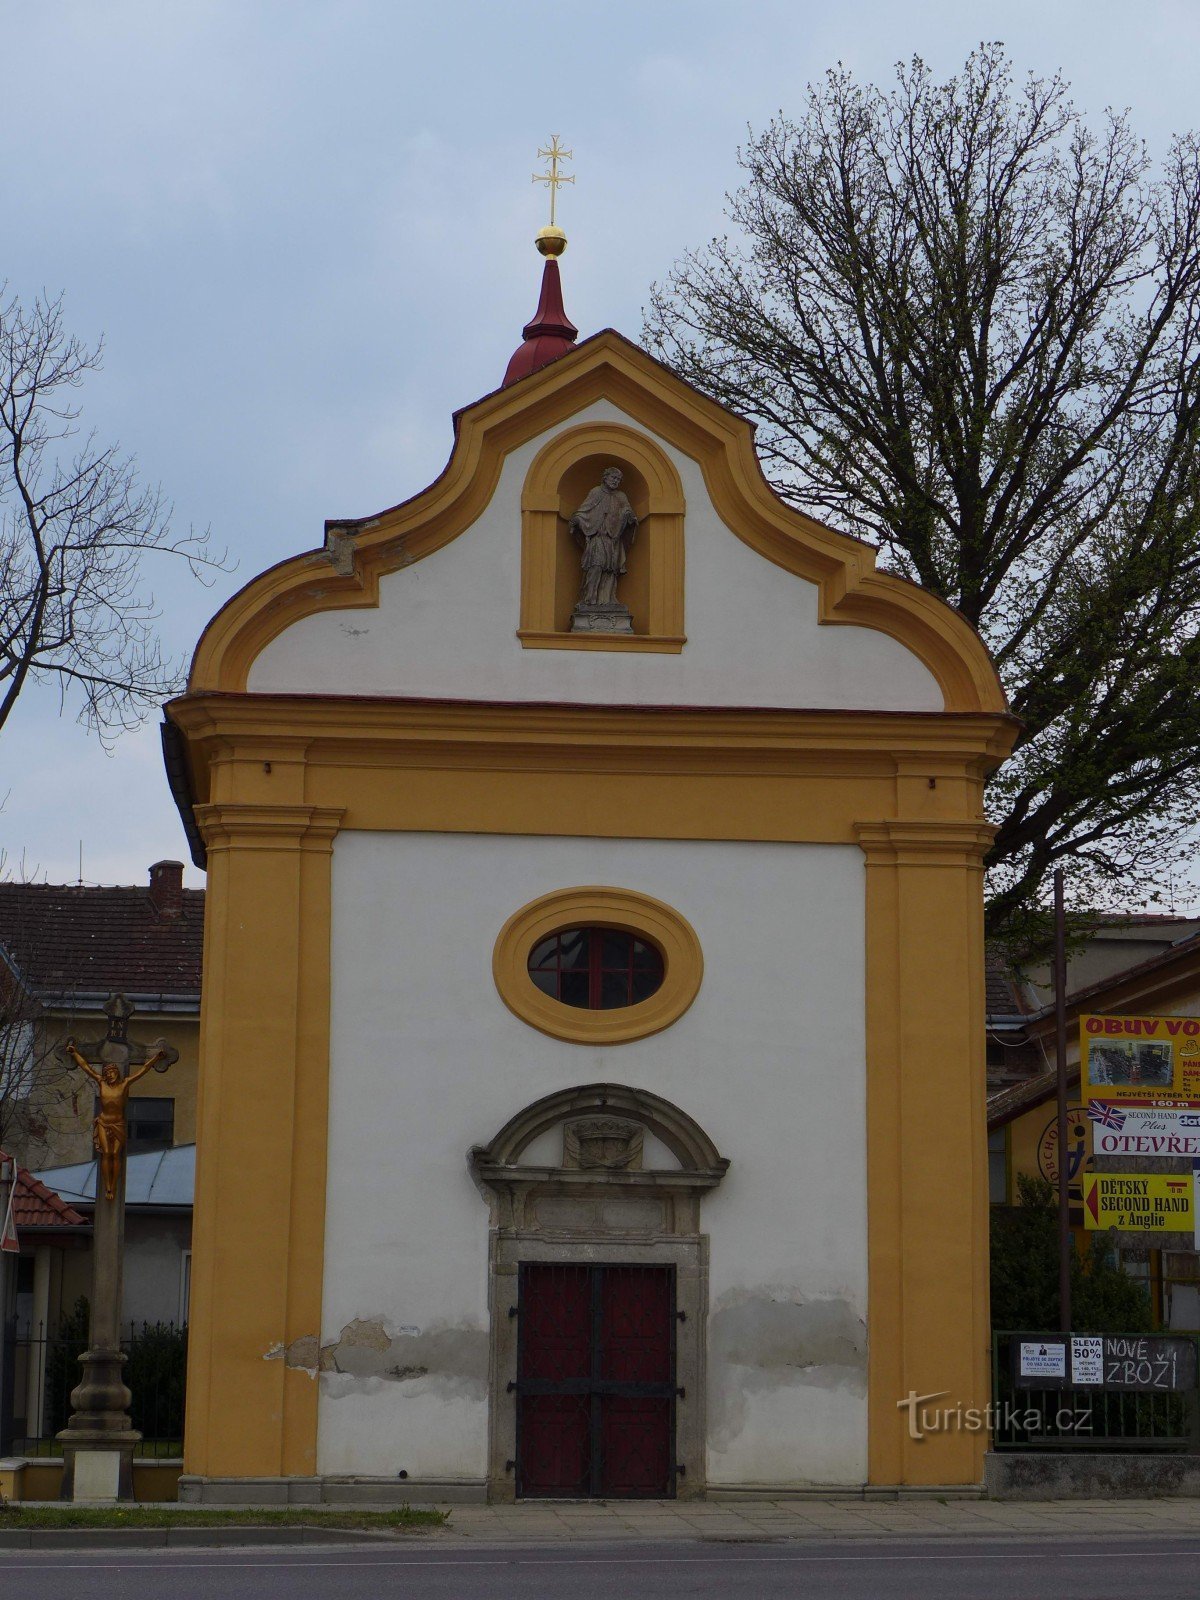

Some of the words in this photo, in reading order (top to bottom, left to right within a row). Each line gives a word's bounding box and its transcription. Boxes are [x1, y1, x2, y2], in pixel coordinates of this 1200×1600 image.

[1086, 1018, 1159, 1035] OBUV
[1116, 1090, 1154, 1098] NEJVĚTŠÍ
[1156, 1090, 1183, 1099] VÝBĚR
[1128, 1111, 1156, 1120] SECOND
[1157, 1112, 1178, 1120] HAND
[1140, 1120, 1166, 1130] Plus
[1101, 1179, 1149, 1195] DĚTSKÝ
[1101, 1196, 1150, 1212] SECOND
[1154, 1197, 1189, 1212] HAND
[1118, 1215, 1125, 1226] z
[1128, 1212, 1165, 1230] Anglie
[1072, 1339, 1101, 1347] SLEVA
[1107, 1338, 1148, 1360] NOVÉ
[1074, 1348, 1101, 1359] 50%
[1106, 1351, 1177, 1389] ZBOŽÍ
